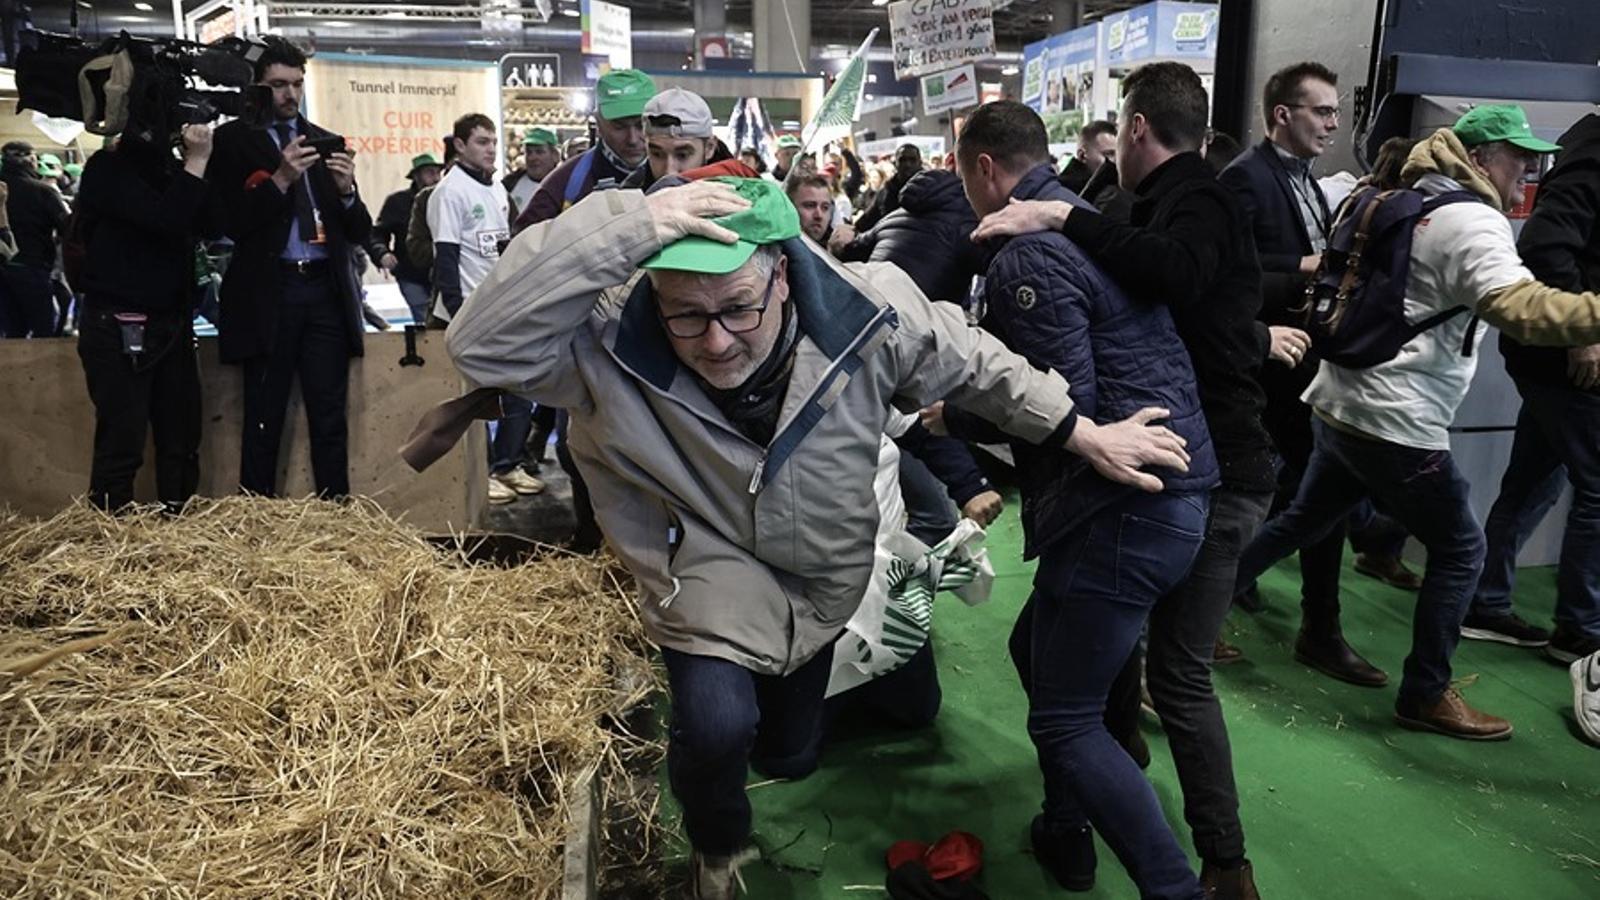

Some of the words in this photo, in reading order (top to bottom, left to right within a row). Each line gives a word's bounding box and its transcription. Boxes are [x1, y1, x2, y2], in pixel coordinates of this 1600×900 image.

[349, 80, 395, 94] Tunnel
[399, 82, 457, 96] Immersif
[383, 111, 433, 129] CUIR
